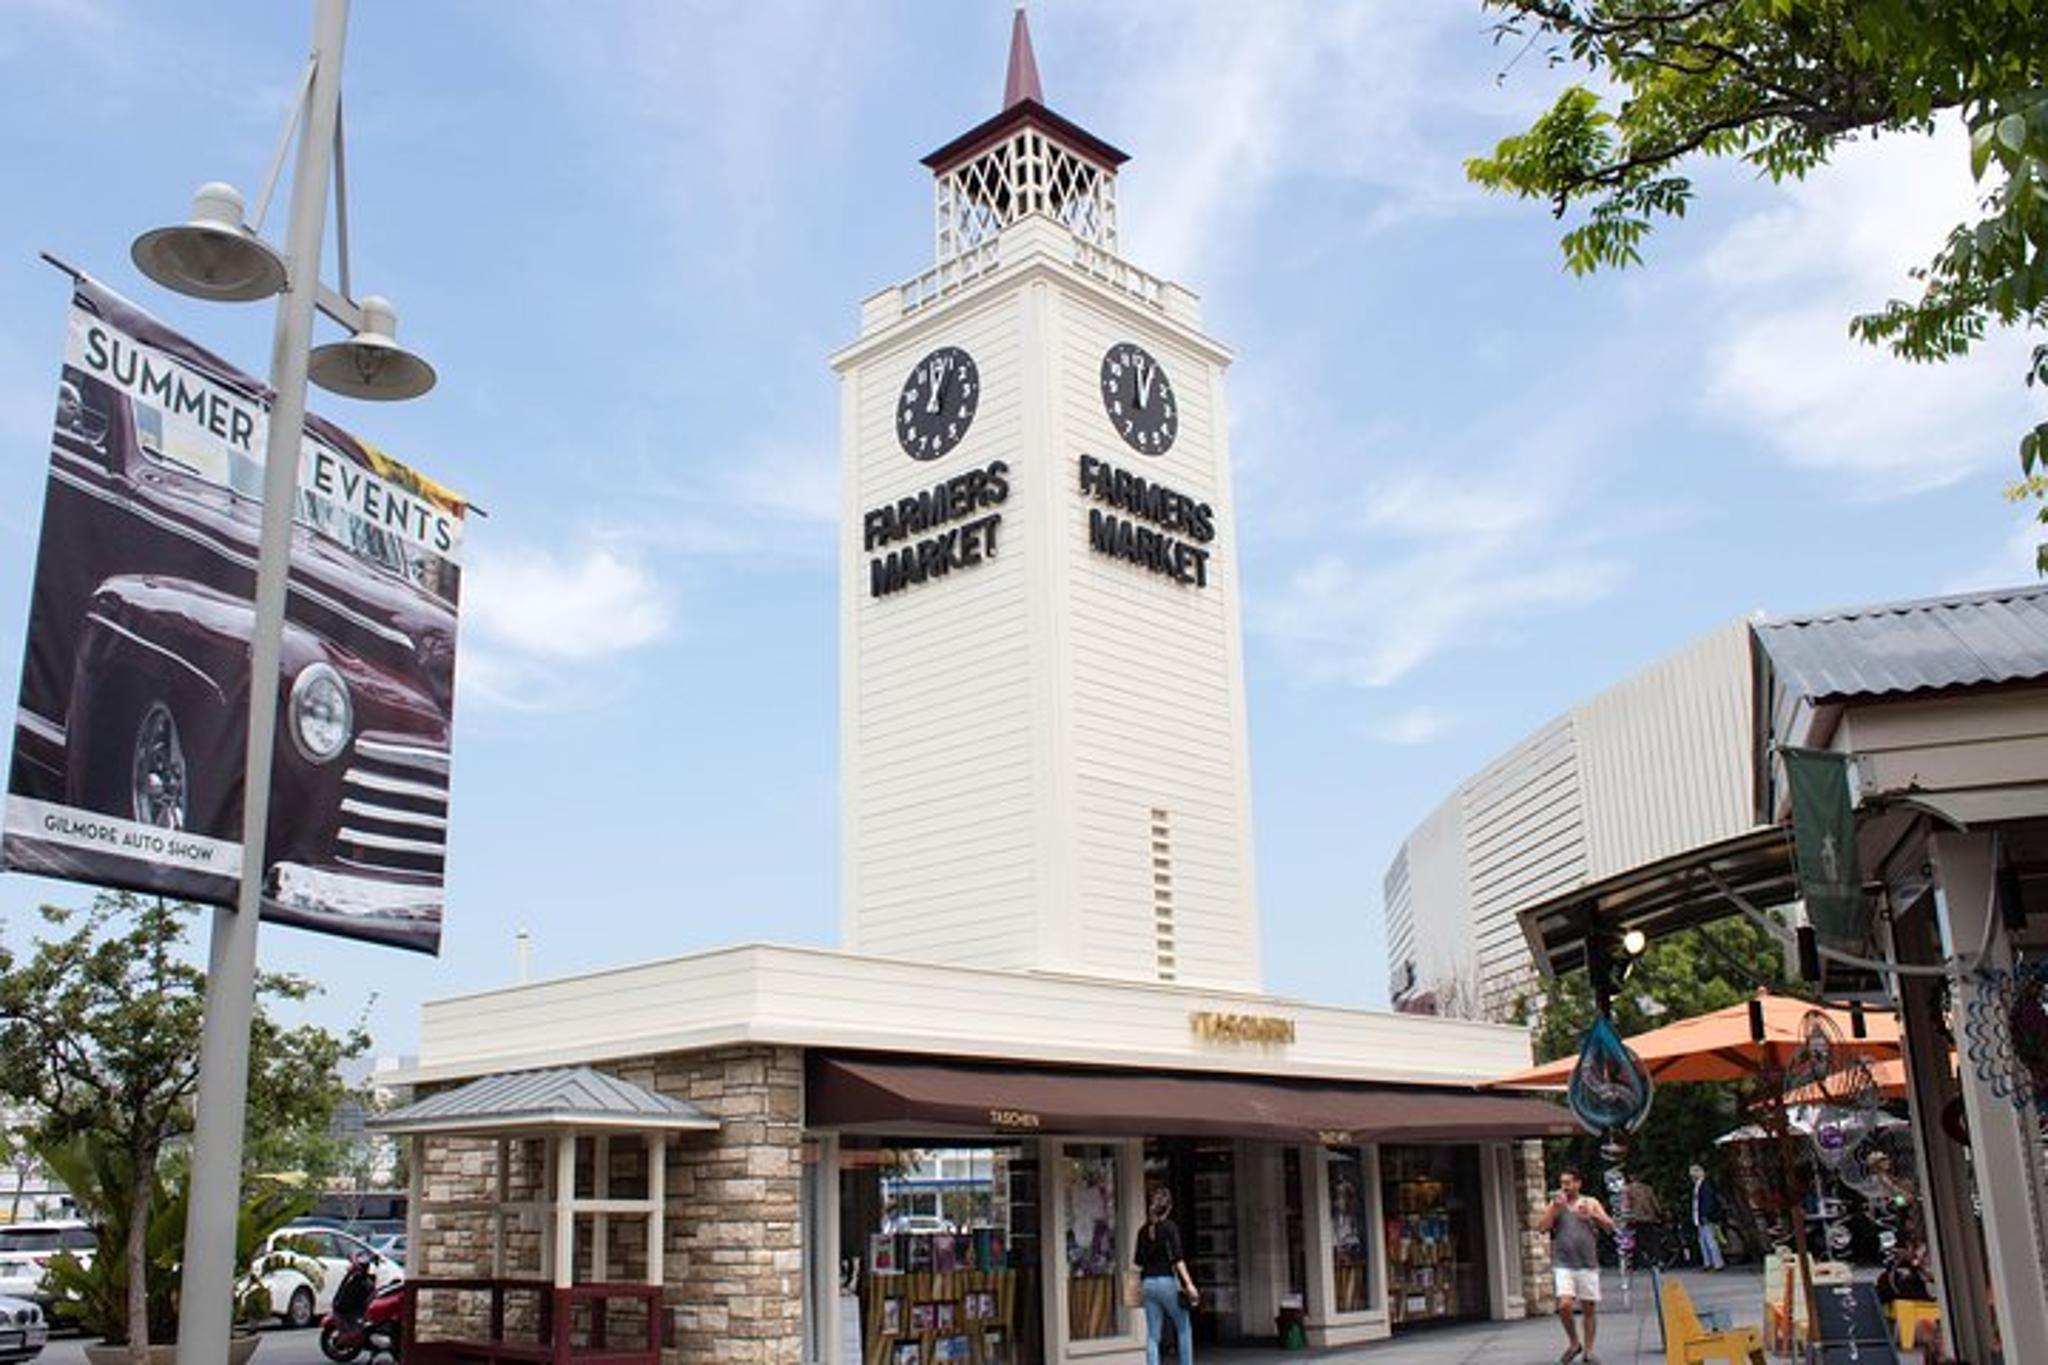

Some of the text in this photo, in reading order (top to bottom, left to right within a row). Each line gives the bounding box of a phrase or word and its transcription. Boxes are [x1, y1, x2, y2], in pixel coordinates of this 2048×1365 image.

[84, 328, 452, 553] SUMMER EVENTS
[865, 460, 1010, 552] FARMERS
[1080, 454, 1215, 544] FARMERS
[870, 513, 1003, 598] MARKET
[1089, 509, 1210, 588] MARKET
[44, 815, 214, 861] GILMORE AUTO SHOW
